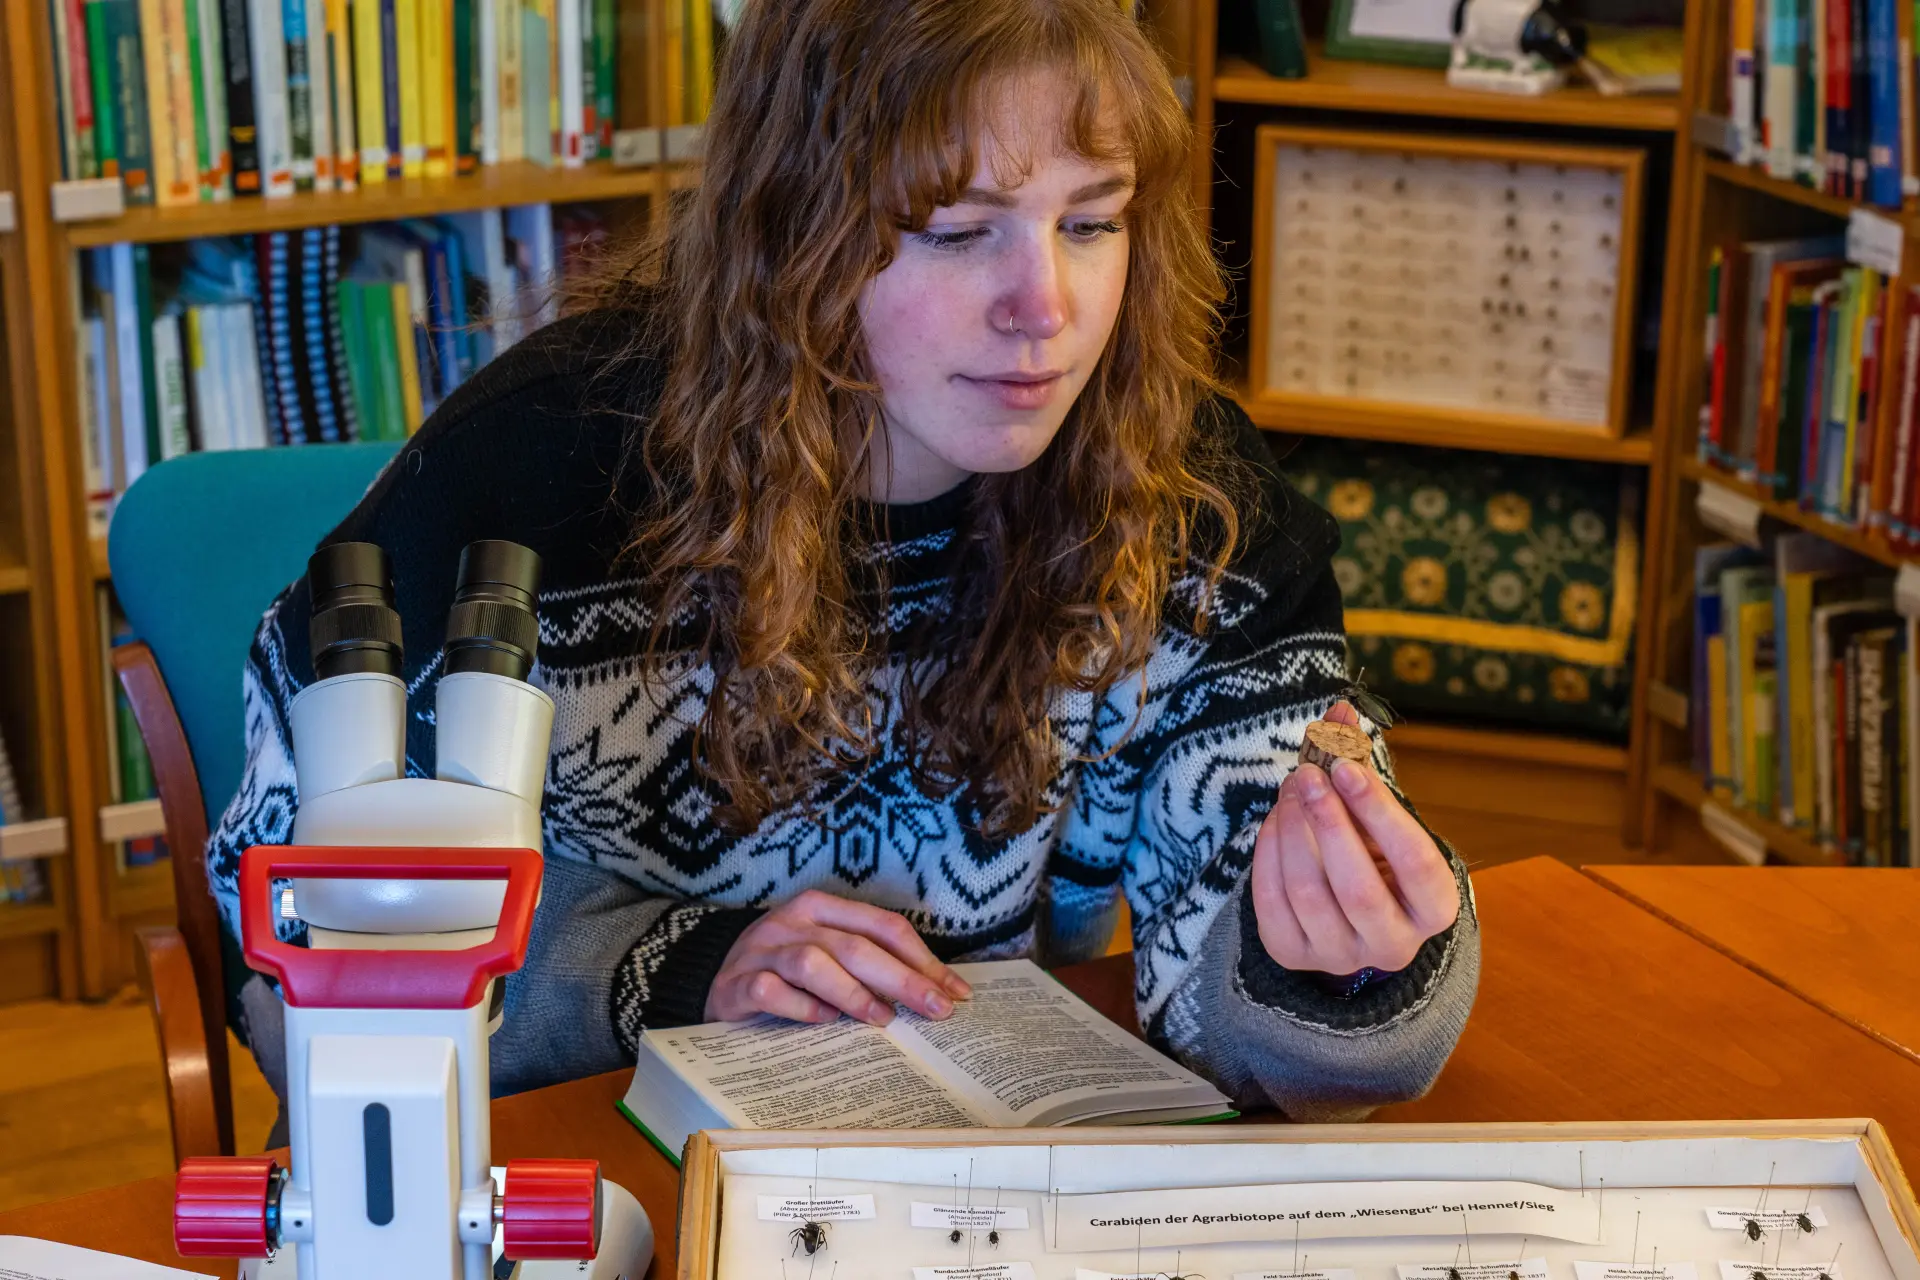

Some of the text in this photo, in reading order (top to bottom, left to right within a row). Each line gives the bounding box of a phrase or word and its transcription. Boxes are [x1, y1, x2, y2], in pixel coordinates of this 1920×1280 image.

[1090, 1215, 1161, 1227] Carabiden
[1164, 1214, 1188, 1224] der
[1191, 1212, 1285, 1225] Agrarbiotope
[1288, 1210, 1311, 1220] auf
[1315, 1210, 1346, 1219] dem
[1442, 1204, 1465, 1213] bei
[1467, 1200, 1555, 1212] Hennef/Sieg
